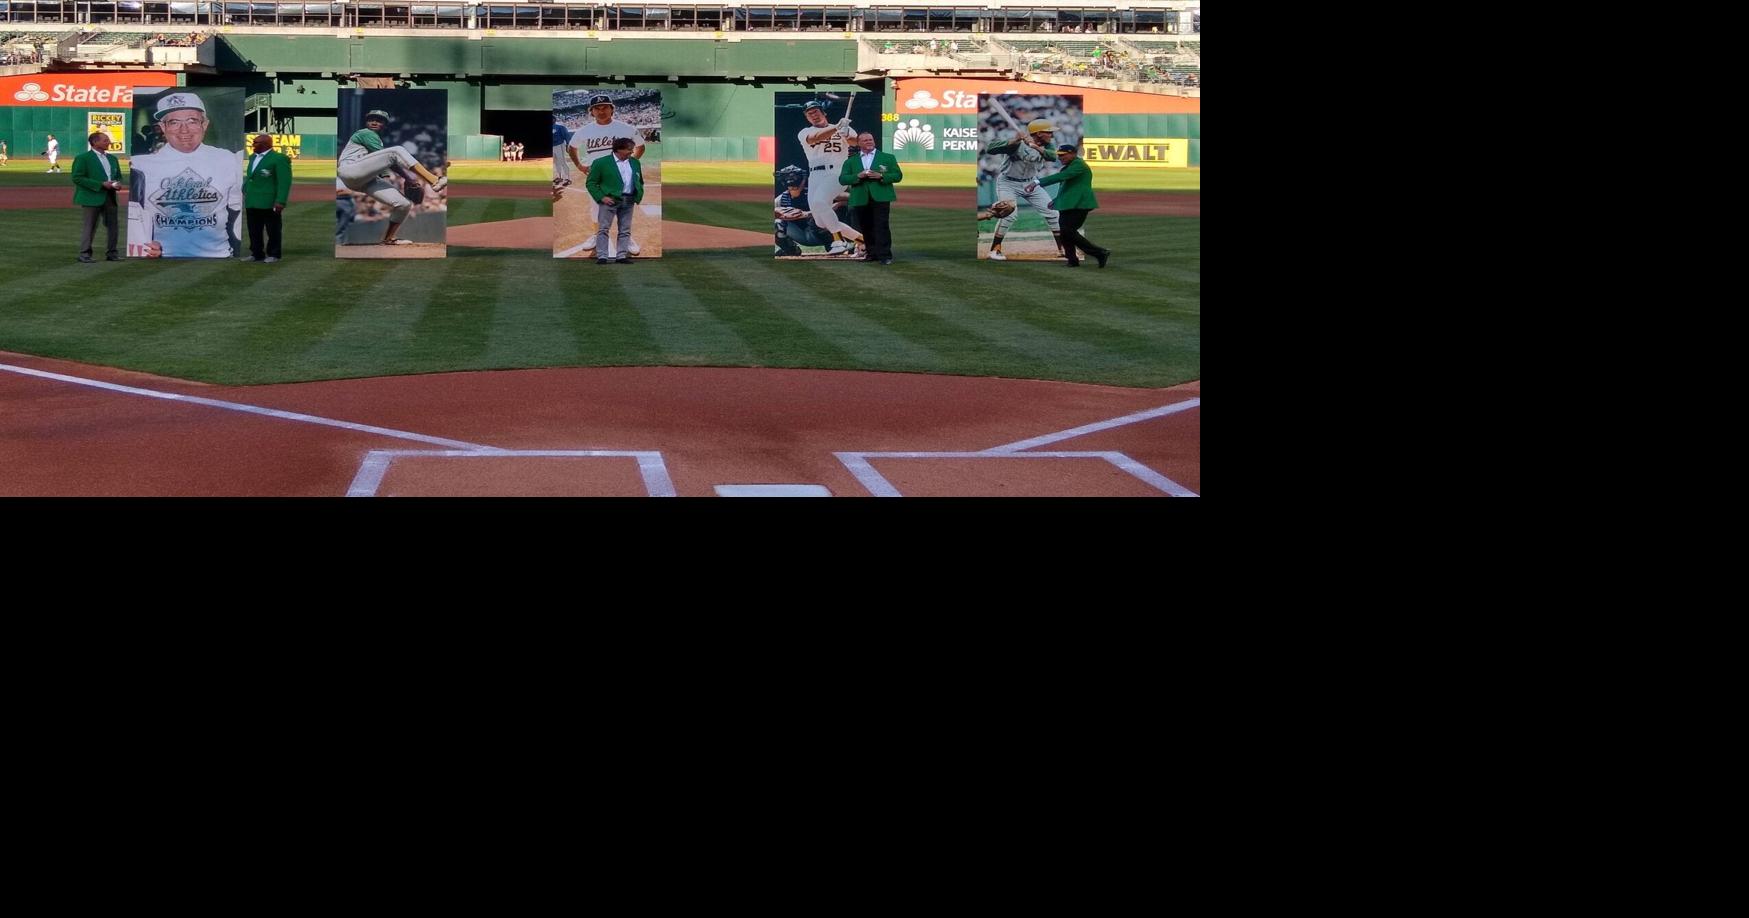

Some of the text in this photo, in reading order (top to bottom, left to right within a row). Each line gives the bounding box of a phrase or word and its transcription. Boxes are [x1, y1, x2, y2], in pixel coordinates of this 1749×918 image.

[943, 128, 978, 138] KAISE
[823, 142, 842, 153] 25
[942, 140, 978, 151] PERM
[156, 187, 218, 202] Athletics
[156, 214, 218, 227] CHAMPIONS
